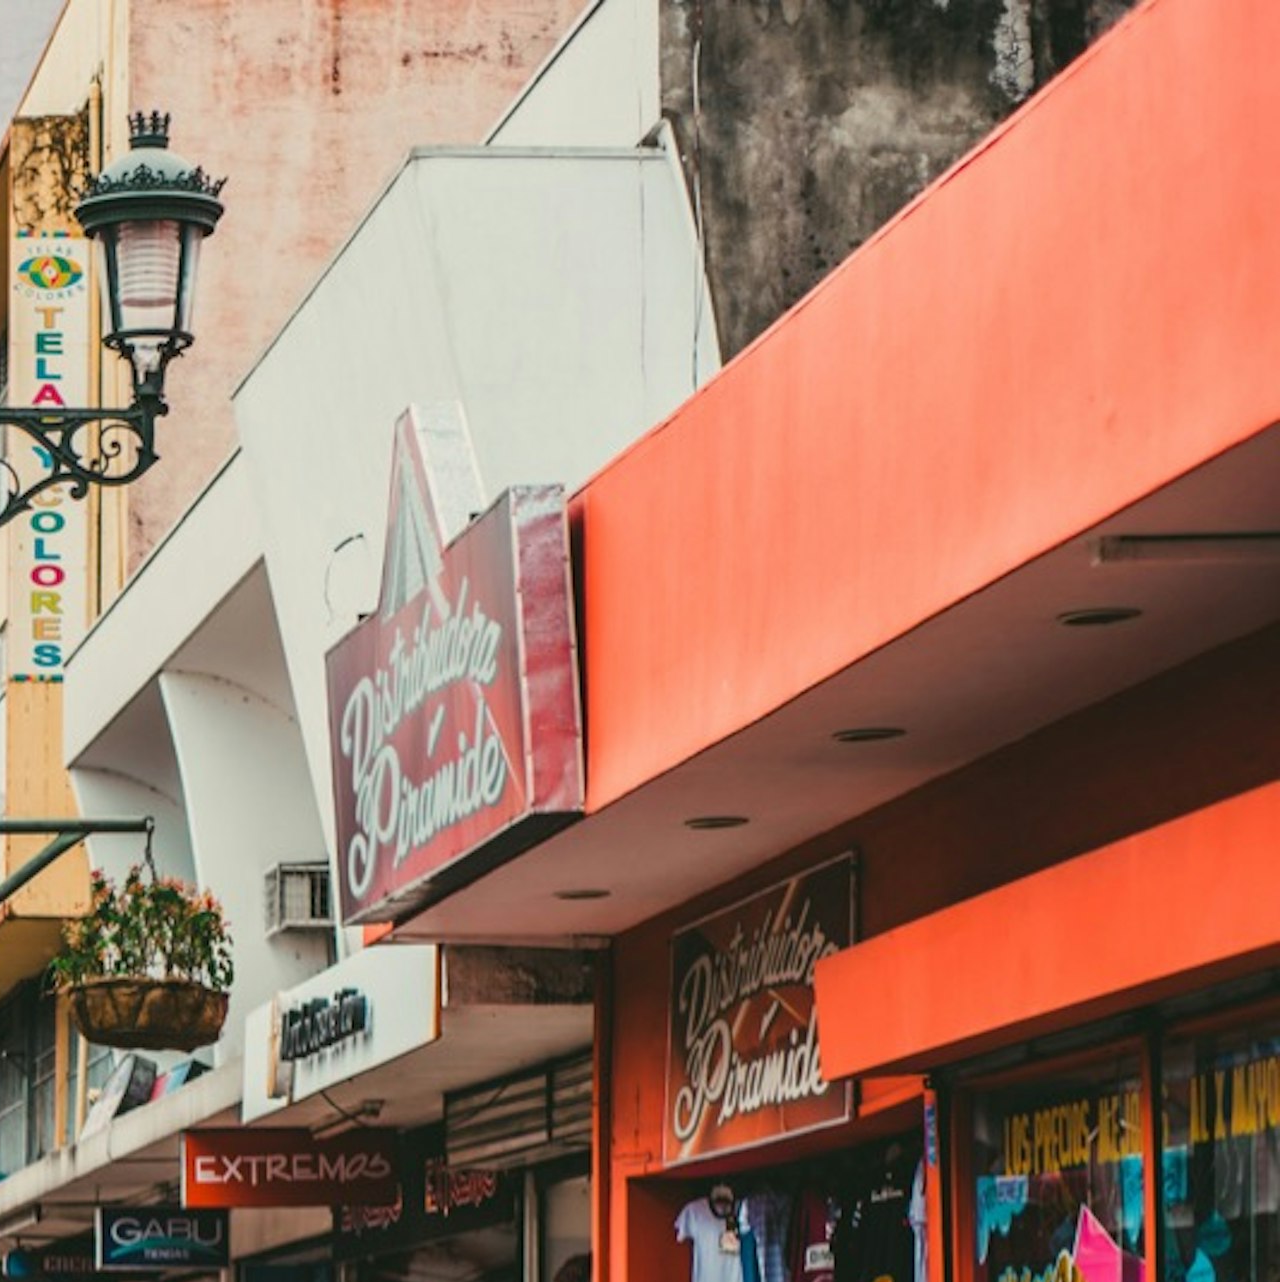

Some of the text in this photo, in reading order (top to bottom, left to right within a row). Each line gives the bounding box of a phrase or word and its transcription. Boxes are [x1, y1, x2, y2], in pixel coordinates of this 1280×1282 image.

[32, 306, 67, 424] TELA
[342, 574, 502, 796] Distribuidora
[346, 690, 515, 900] Pirámide
[194, 1151, 391, 1187] EXTREMOS
[1004, 1112, 1031, 1177] LOS
[109, 1217, 223, 1247] GABU
